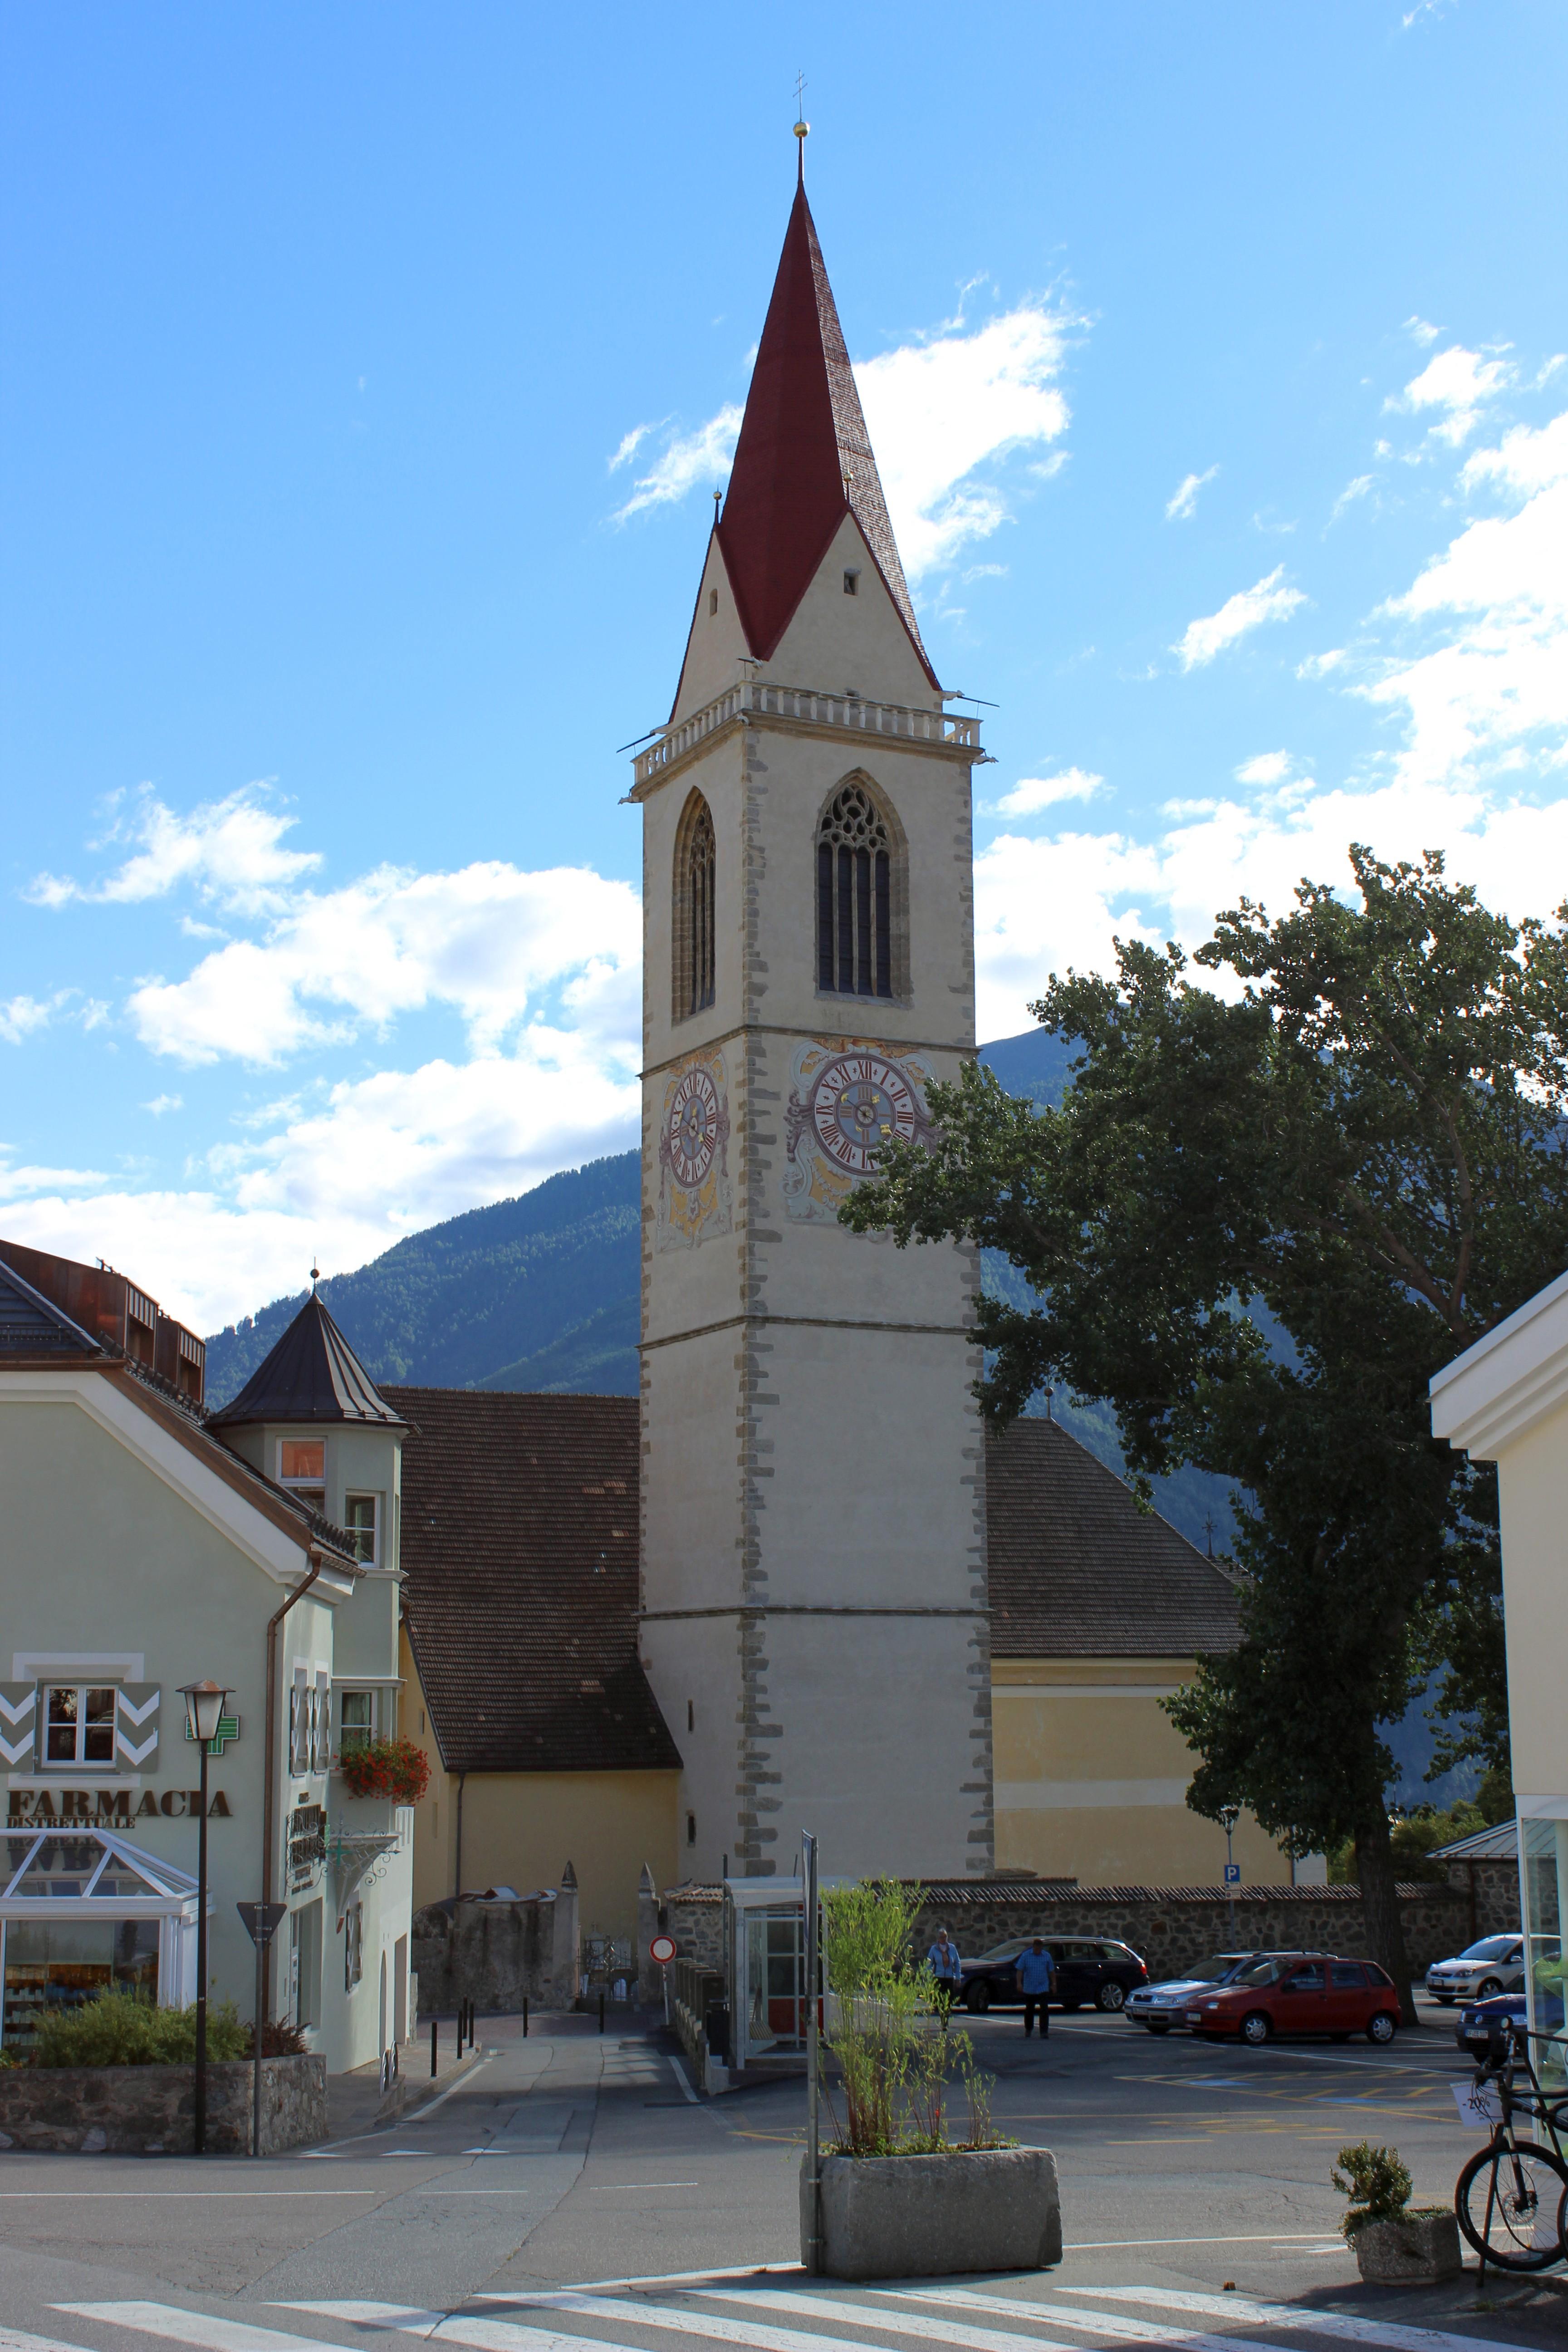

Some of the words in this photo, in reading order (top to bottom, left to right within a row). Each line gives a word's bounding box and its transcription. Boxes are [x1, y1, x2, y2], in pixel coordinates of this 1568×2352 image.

[6, 1790, 233, 1817] FARMACIA
[6, 1817, 136, 1829] DISTRETTUALE
[1228, 1867, 1237, 1880] P
